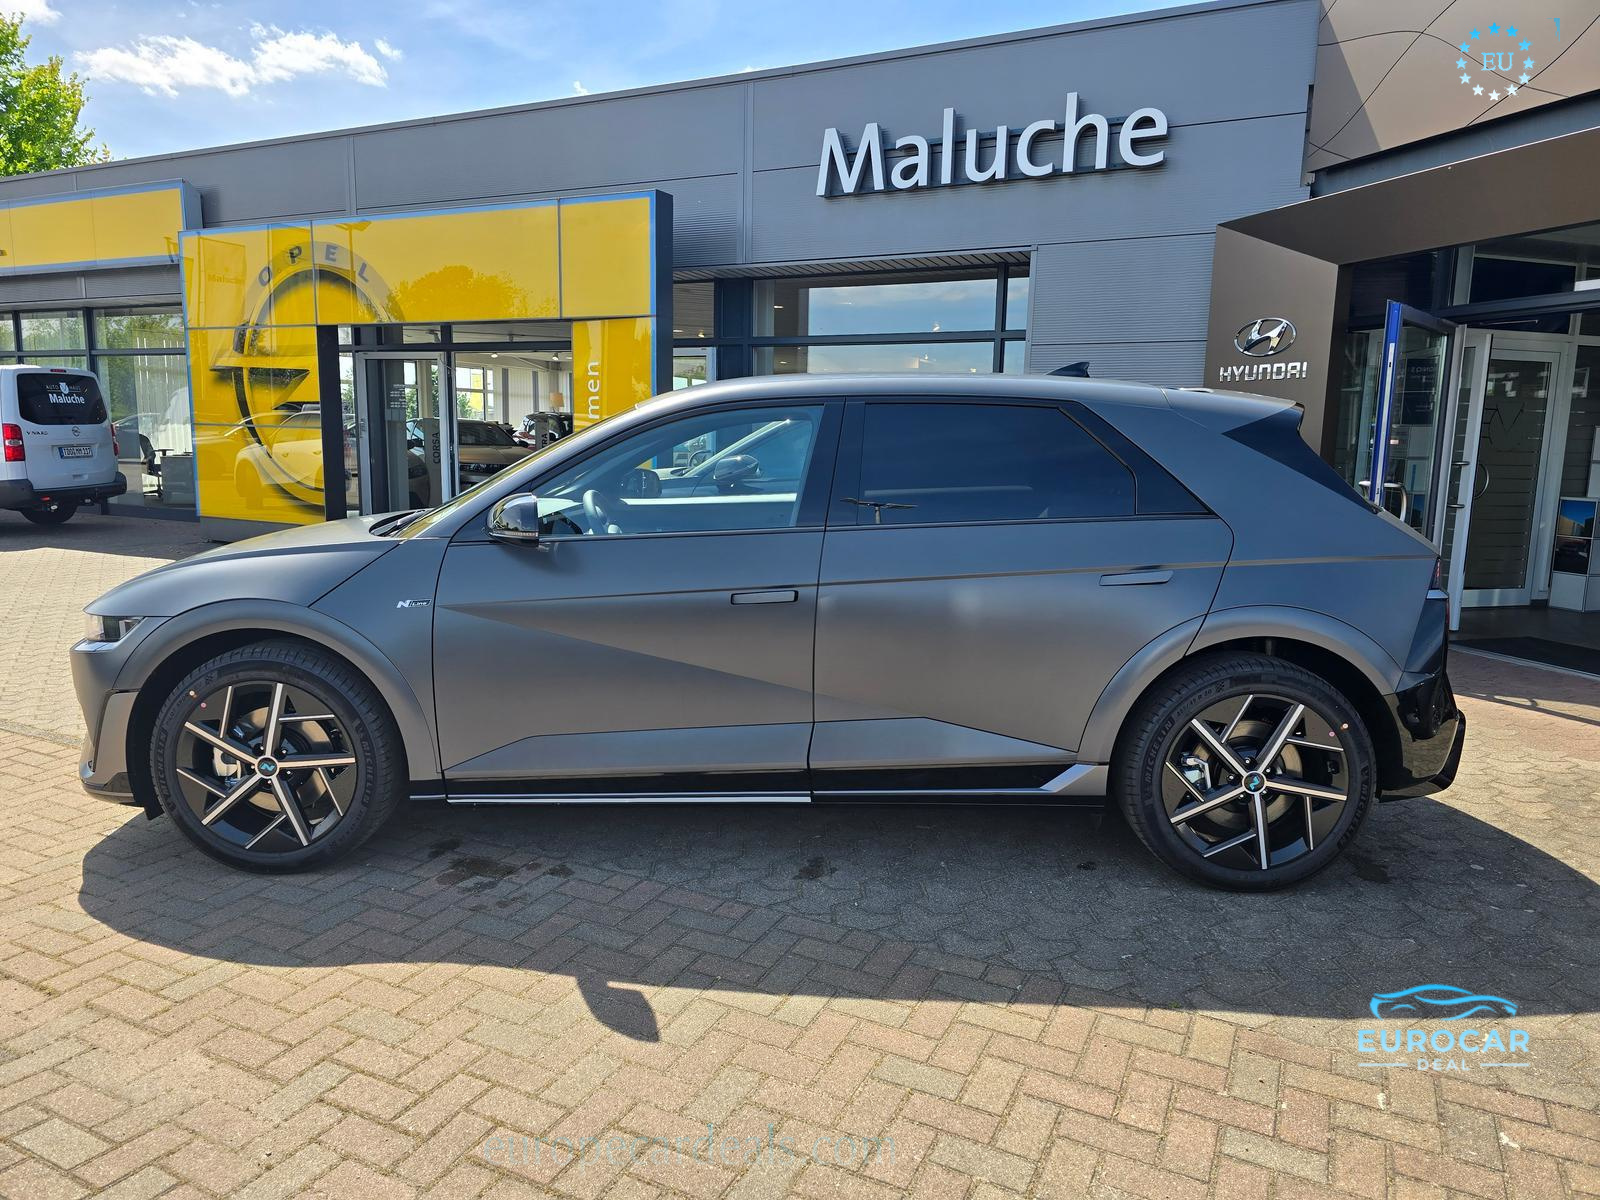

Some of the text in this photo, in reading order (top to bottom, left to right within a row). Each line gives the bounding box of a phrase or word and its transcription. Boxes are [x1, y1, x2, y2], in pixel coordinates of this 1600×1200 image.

[816, 92, 1168, 197] Maluche
[258, 244, 369, 287] OPEL
[1219, 361, 1308, 382] HYUNDAI
[49, 392, 85, 404] Maluche
[432, 431, 441, 464] CORSA
[361, 739, 374, 804] MICHELIN
[1144, 720, 1175, 784] MICHELIN
